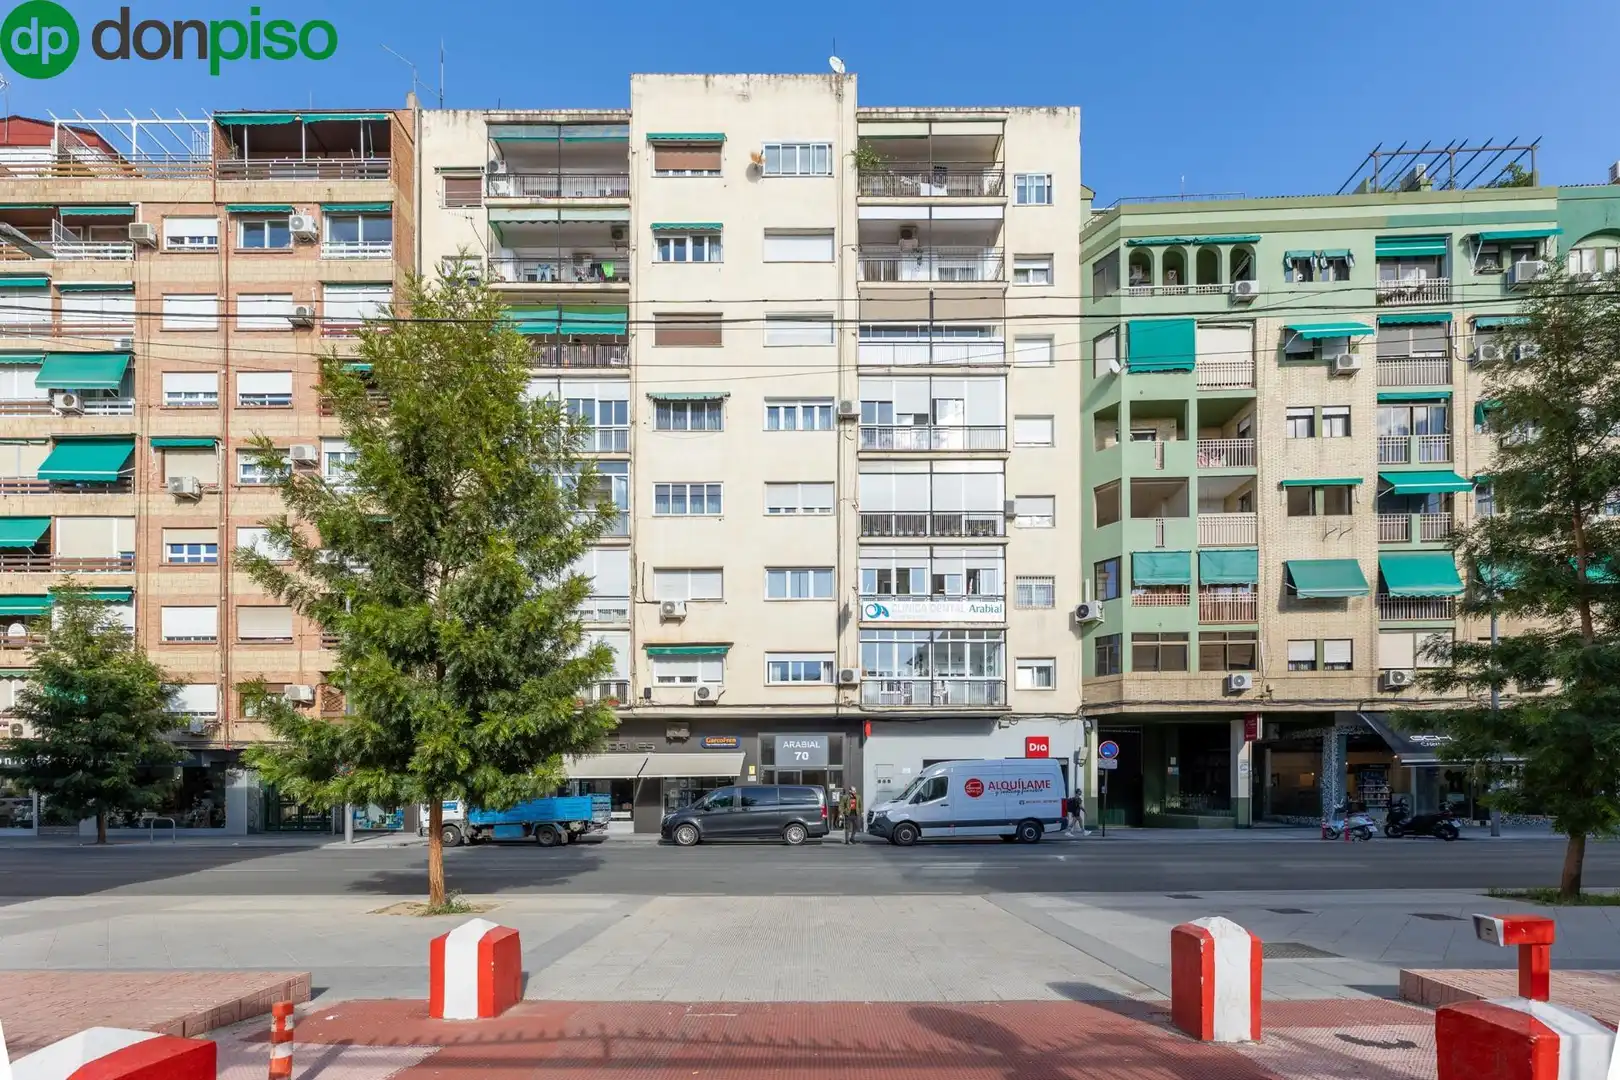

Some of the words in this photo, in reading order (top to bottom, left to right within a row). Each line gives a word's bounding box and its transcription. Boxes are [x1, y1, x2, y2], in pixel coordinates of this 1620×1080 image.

[969, 603, 1003, 613] Arabial
[783, 740, 821, 749] ARABIAL
[794, 751, 809, 761] 70
[988, 779, 1051, 790] ALQUÍLAME
